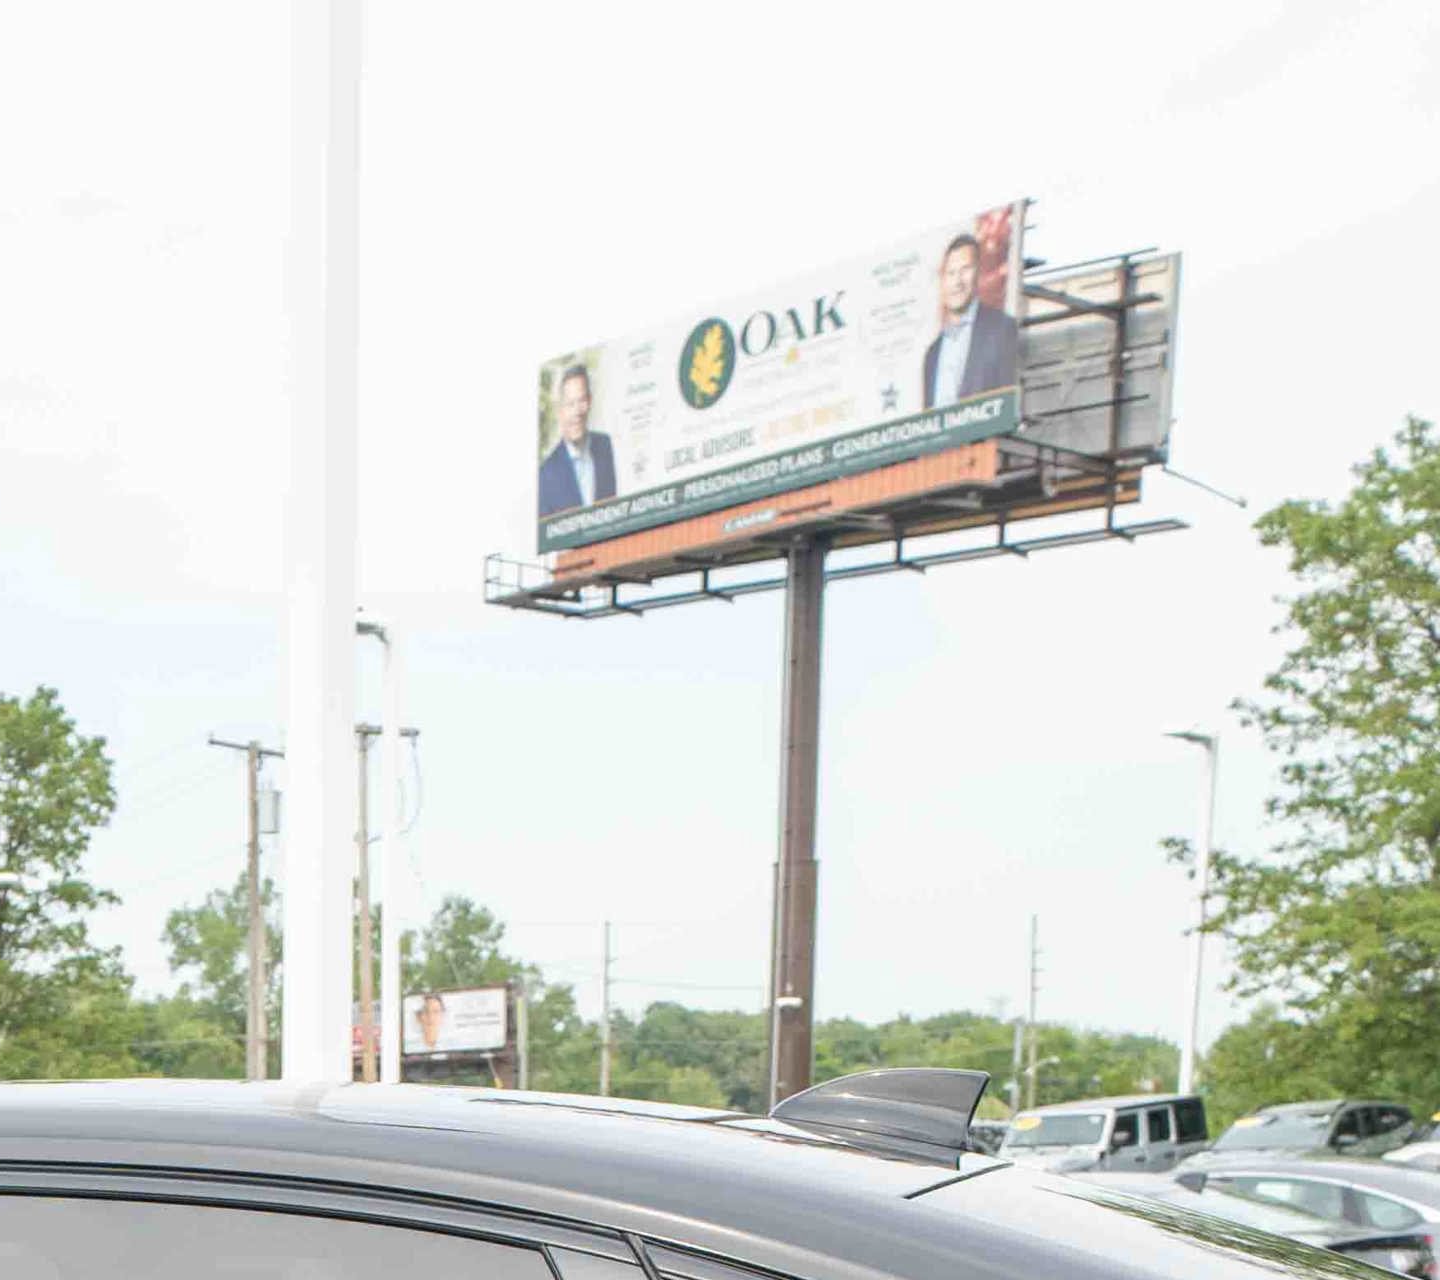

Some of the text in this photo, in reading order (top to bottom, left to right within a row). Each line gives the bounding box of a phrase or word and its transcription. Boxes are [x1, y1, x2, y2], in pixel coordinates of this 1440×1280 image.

[741, 290, 847, 356] OAK
[831, 415, 942, 459] GENERATIONAL
[944, 399, 1005, 431] IMPACT
